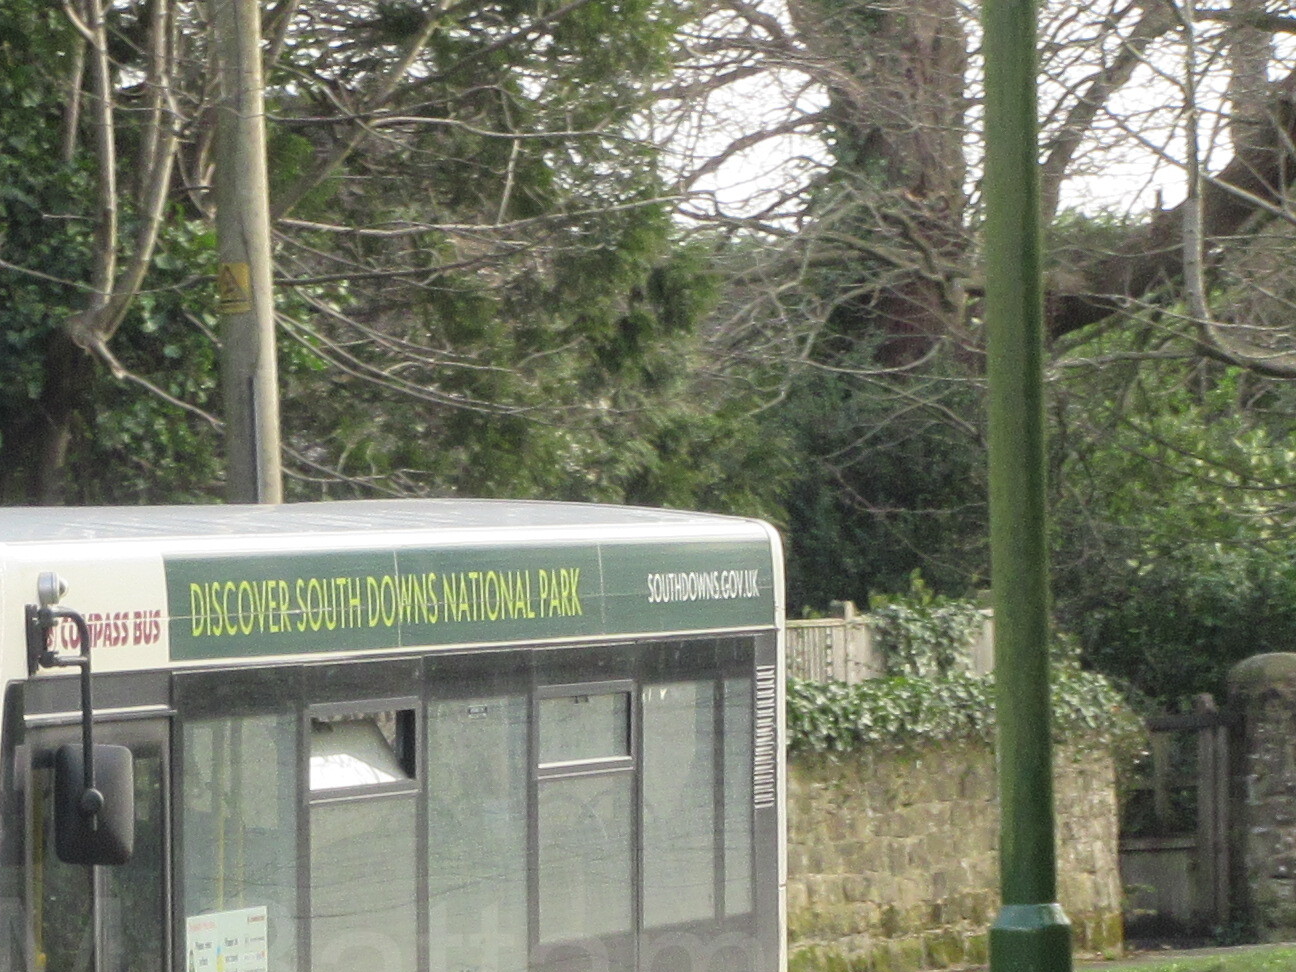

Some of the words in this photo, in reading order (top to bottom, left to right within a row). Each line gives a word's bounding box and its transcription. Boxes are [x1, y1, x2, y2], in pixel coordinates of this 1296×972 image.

[189, 580, 292, 637] DISCOVER
[295, 577, 362, 632] SOUTH
[366, 572, 439, 627] DOWNS
[443, 570, 536, 622] NATIONAL
[538, 568, 584, 618] PARK
[647, 569, 761, 603] SOUTHDOWNS.GOV.UK
[132, 609, 162, 646] BUS
